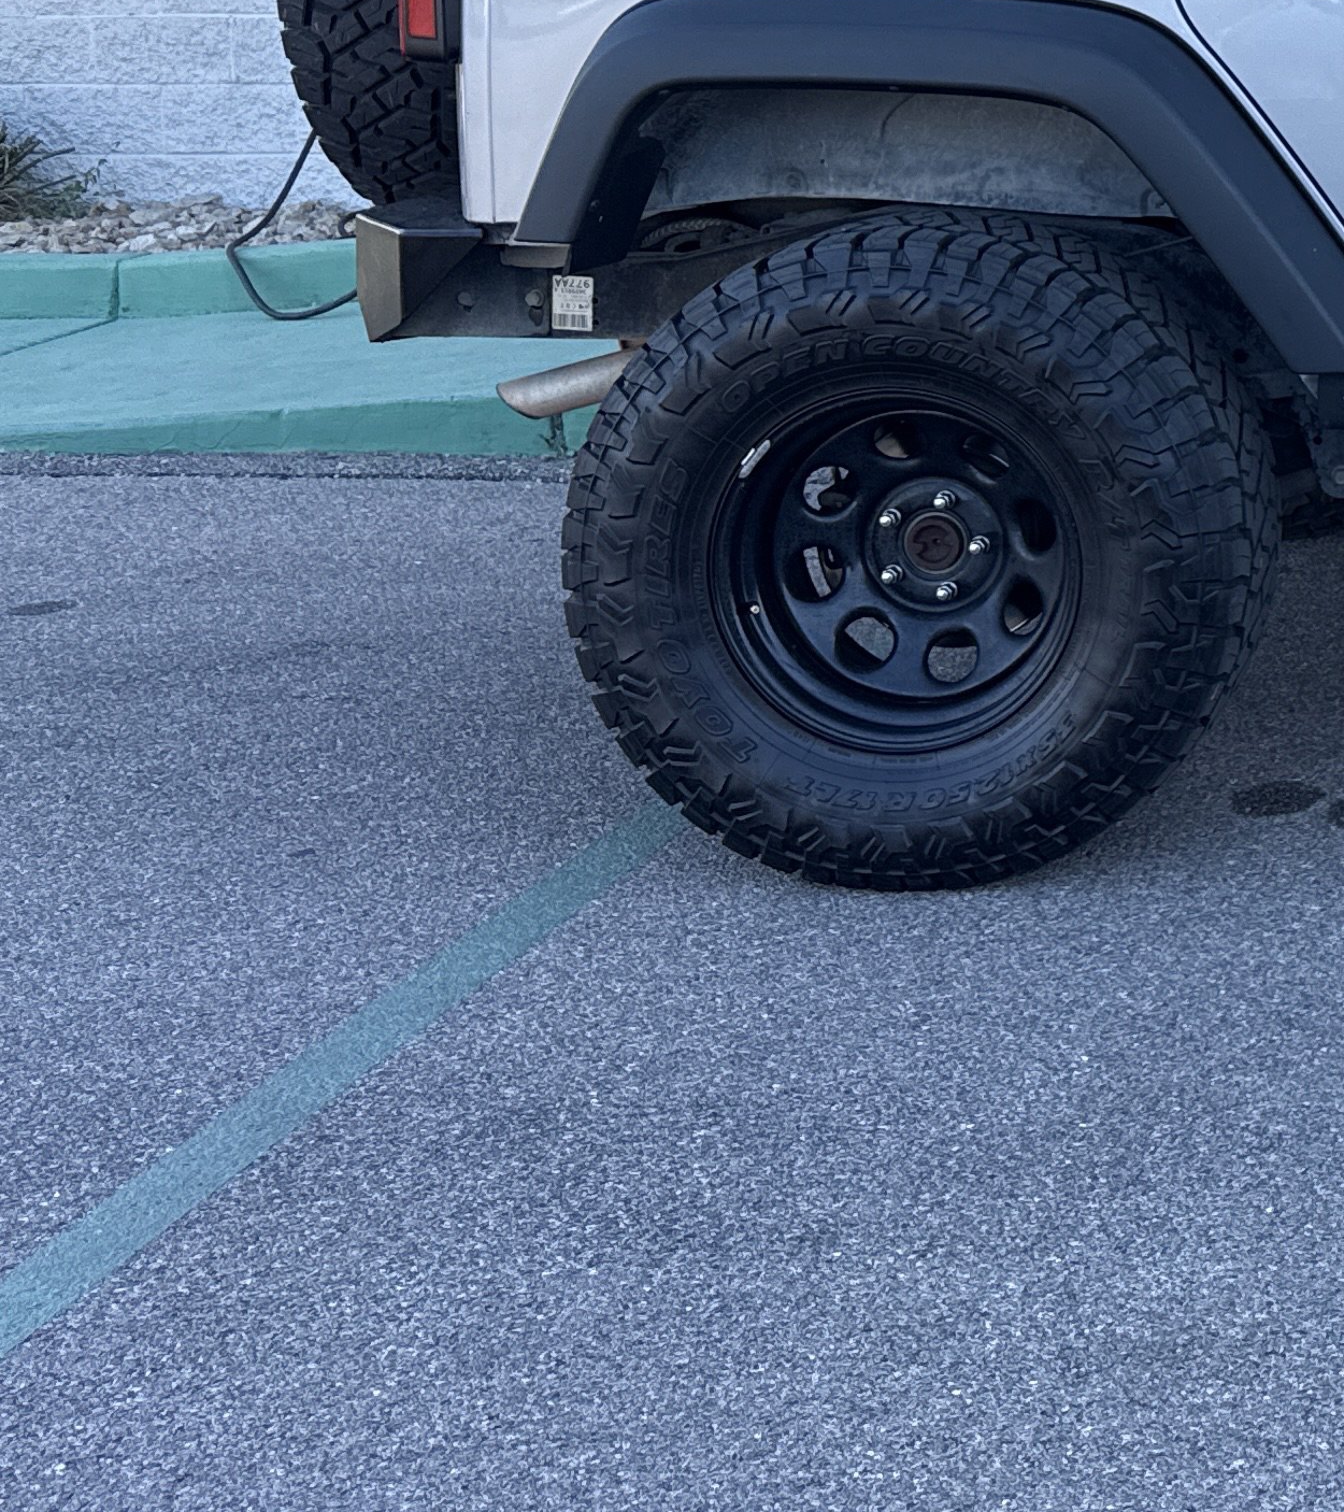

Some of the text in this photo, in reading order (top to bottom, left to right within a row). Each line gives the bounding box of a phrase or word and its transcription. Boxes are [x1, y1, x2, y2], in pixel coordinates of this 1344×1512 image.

[721, 338, 849, 413] OPEN
[862, 336, 1087, 439] COUNTRY
[644, 456, 757, 763] TOYO TIRES
